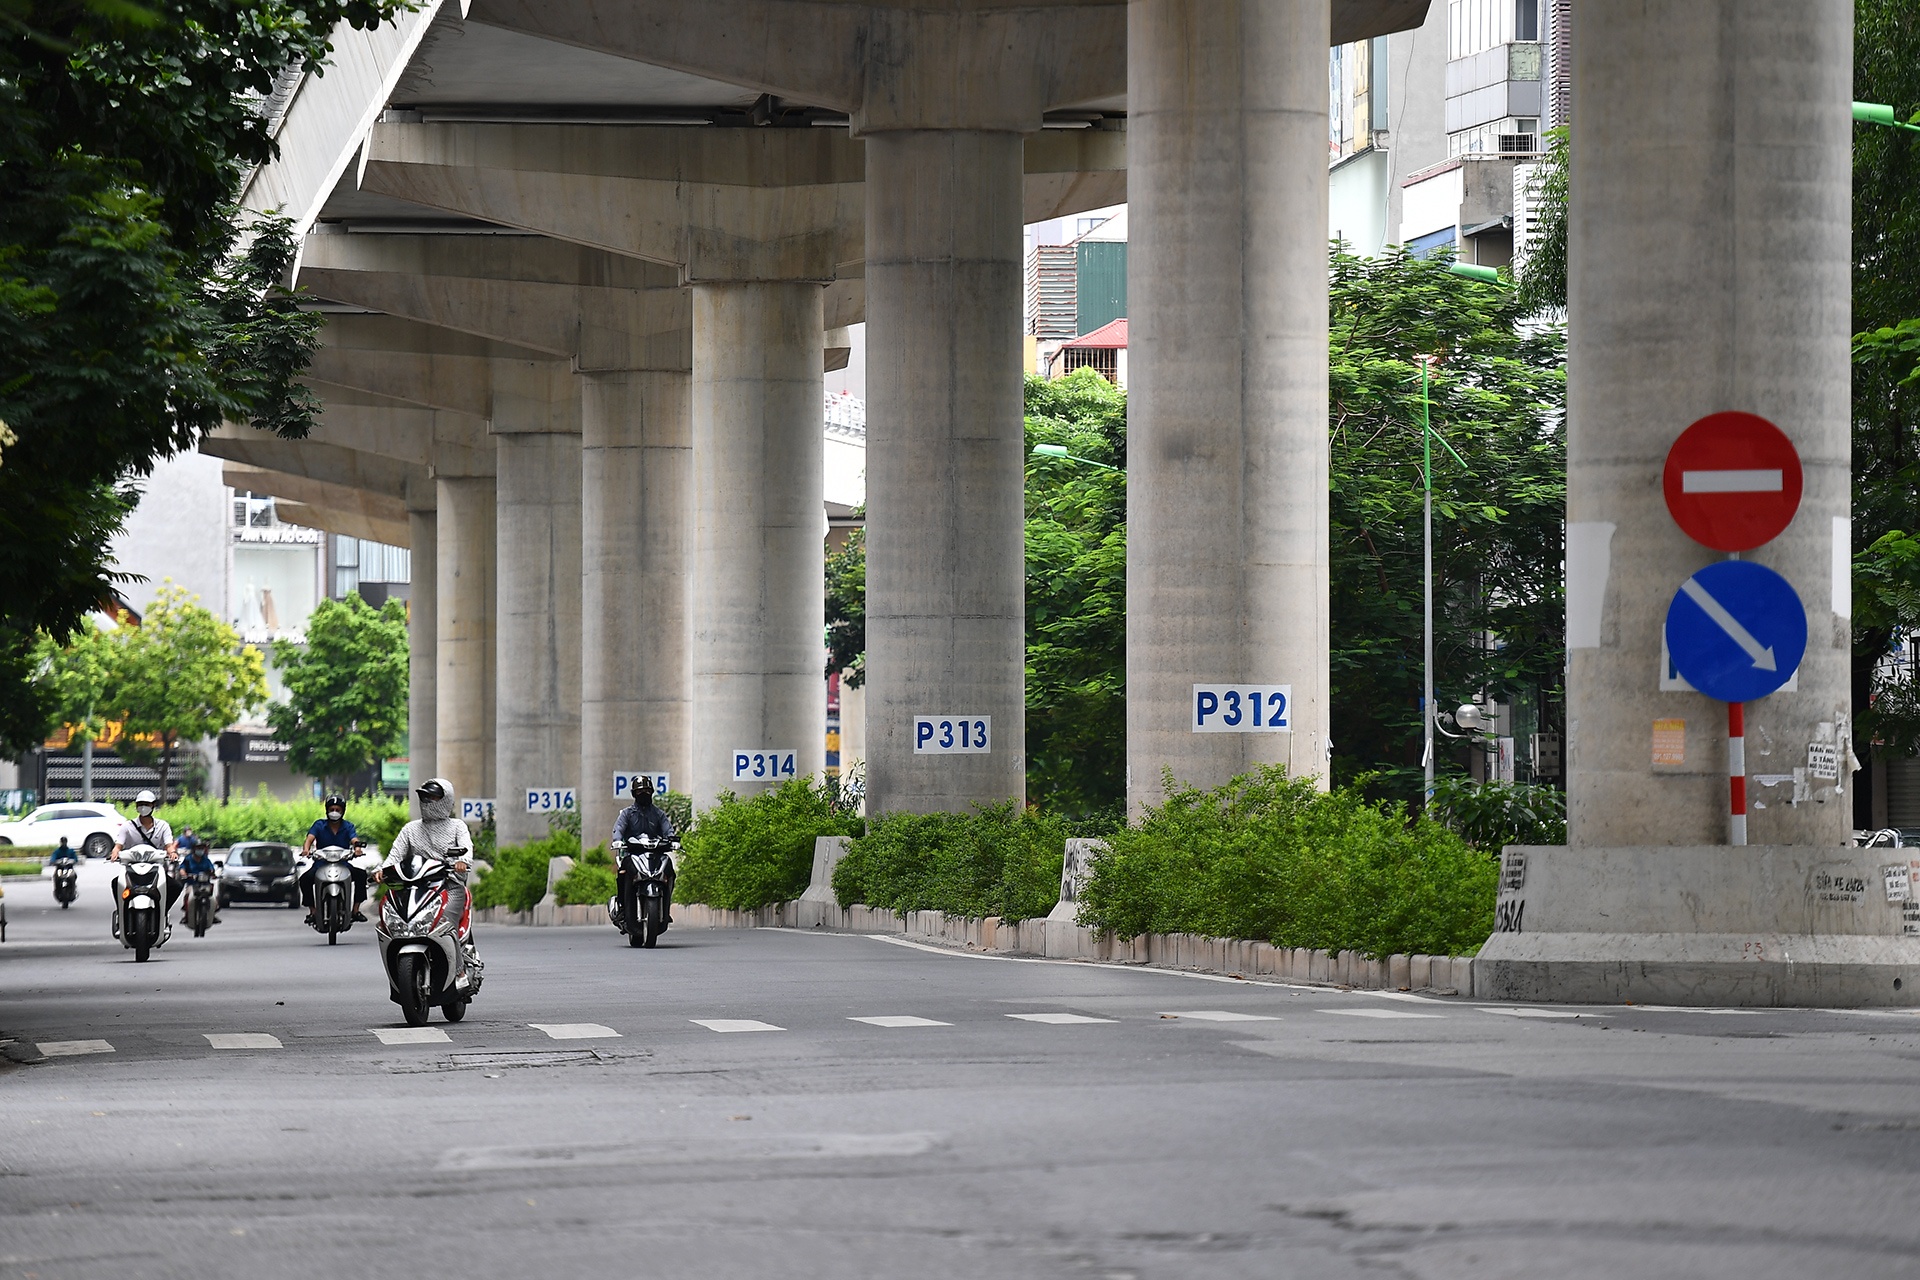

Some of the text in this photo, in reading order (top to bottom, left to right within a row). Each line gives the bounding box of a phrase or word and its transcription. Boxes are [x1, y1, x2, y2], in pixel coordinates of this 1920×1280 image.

[1197, 690, 1287, 727] P312
[917, 720, 987, 750] P313
[735, 754, 795, 778] P314
[615, 776, 667, 796] P5
[528, 791, 574, 809] P316
